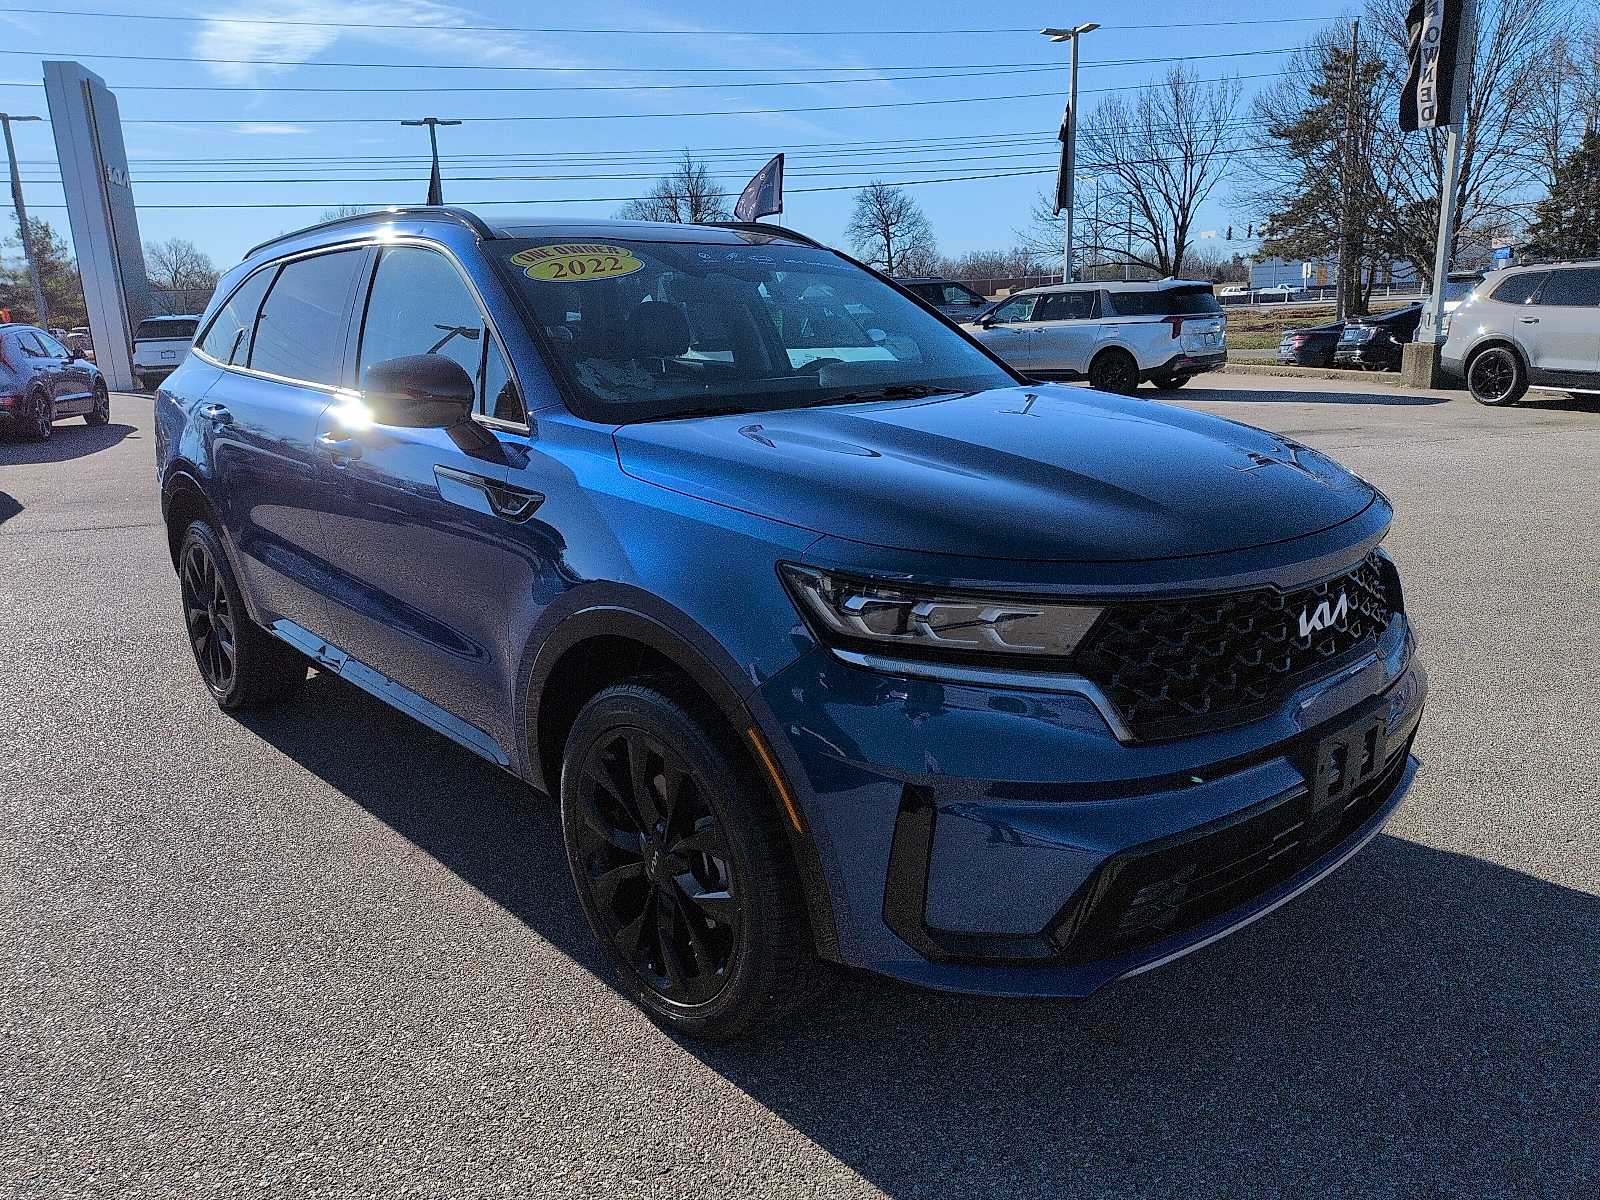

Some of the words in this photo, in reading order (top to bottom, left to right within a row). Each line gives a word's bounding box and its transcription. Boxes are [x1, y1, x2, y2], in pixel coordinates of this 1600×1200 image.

[516, 248, 555, 263] ONE
[554, 245, 621, 255] OWNER
[548, 256, 623, 279] 2022
